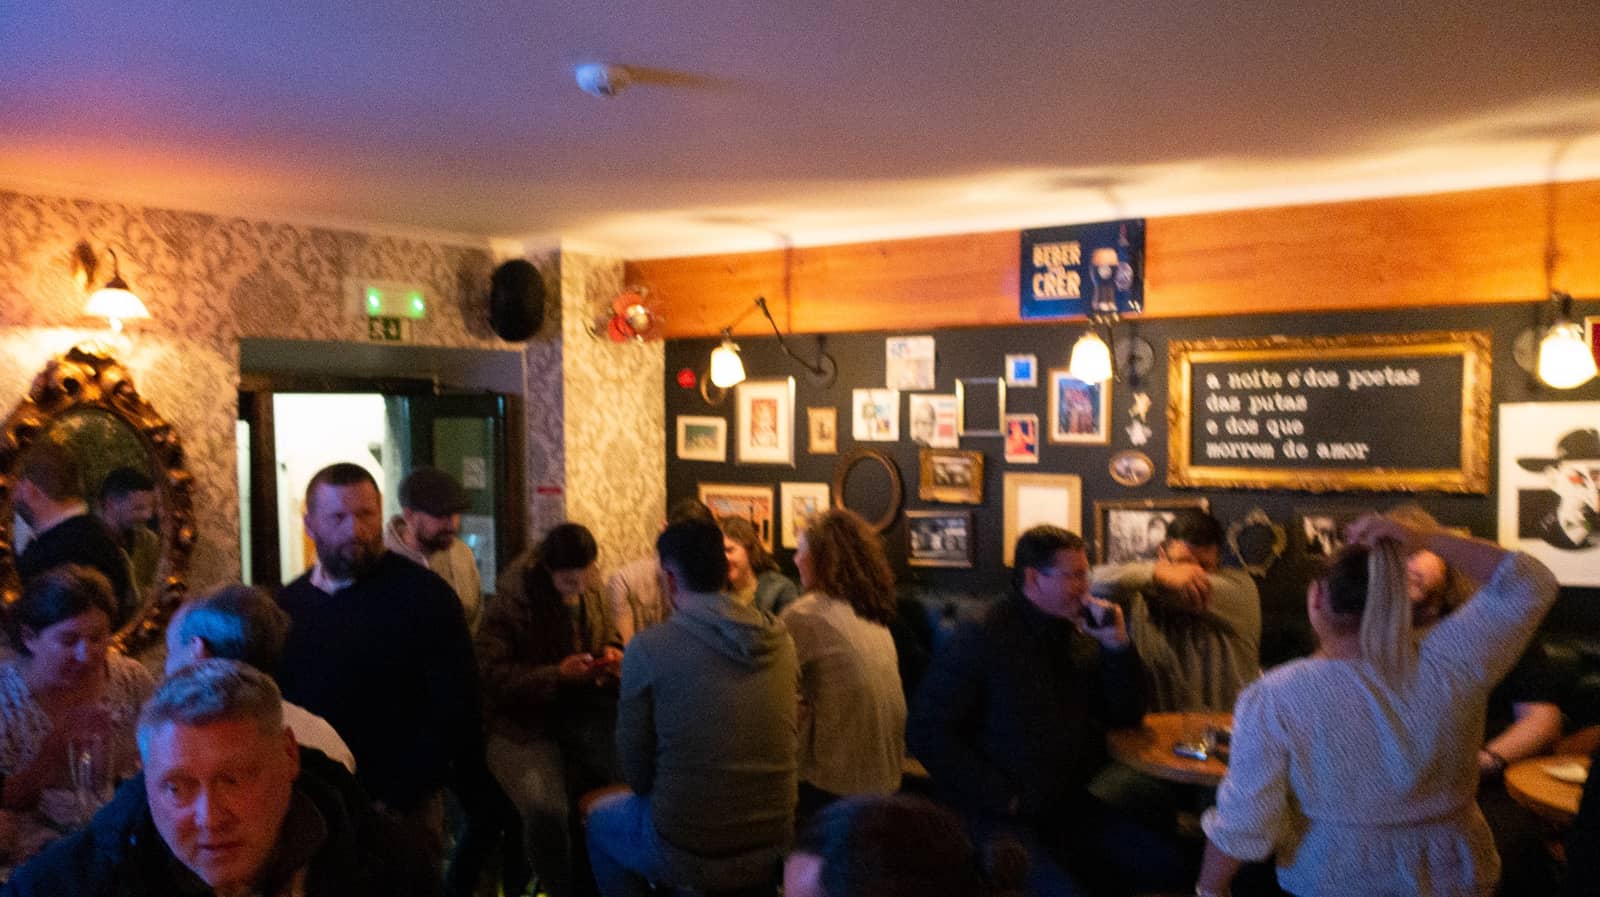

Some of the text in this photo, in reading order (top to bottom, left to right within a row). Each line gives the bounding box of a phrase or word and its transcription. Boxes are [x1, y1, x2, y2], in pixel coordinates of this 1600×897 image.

[1033, 243, 1081, 267] BEBER
[1033, 270, 1081, 297] CRER
[1206, 373, 1221, 389] a
[1228, 369, 1283, 389] noite
[1303, 367, 1339, 388] dos
[1348, 366, 1420, 391] poetas
[1206, 392, 1307, 415] das putas
[1206, 415, 1304, 438] e dos que
[1206, 439, 1370, 459] morrem de amor
